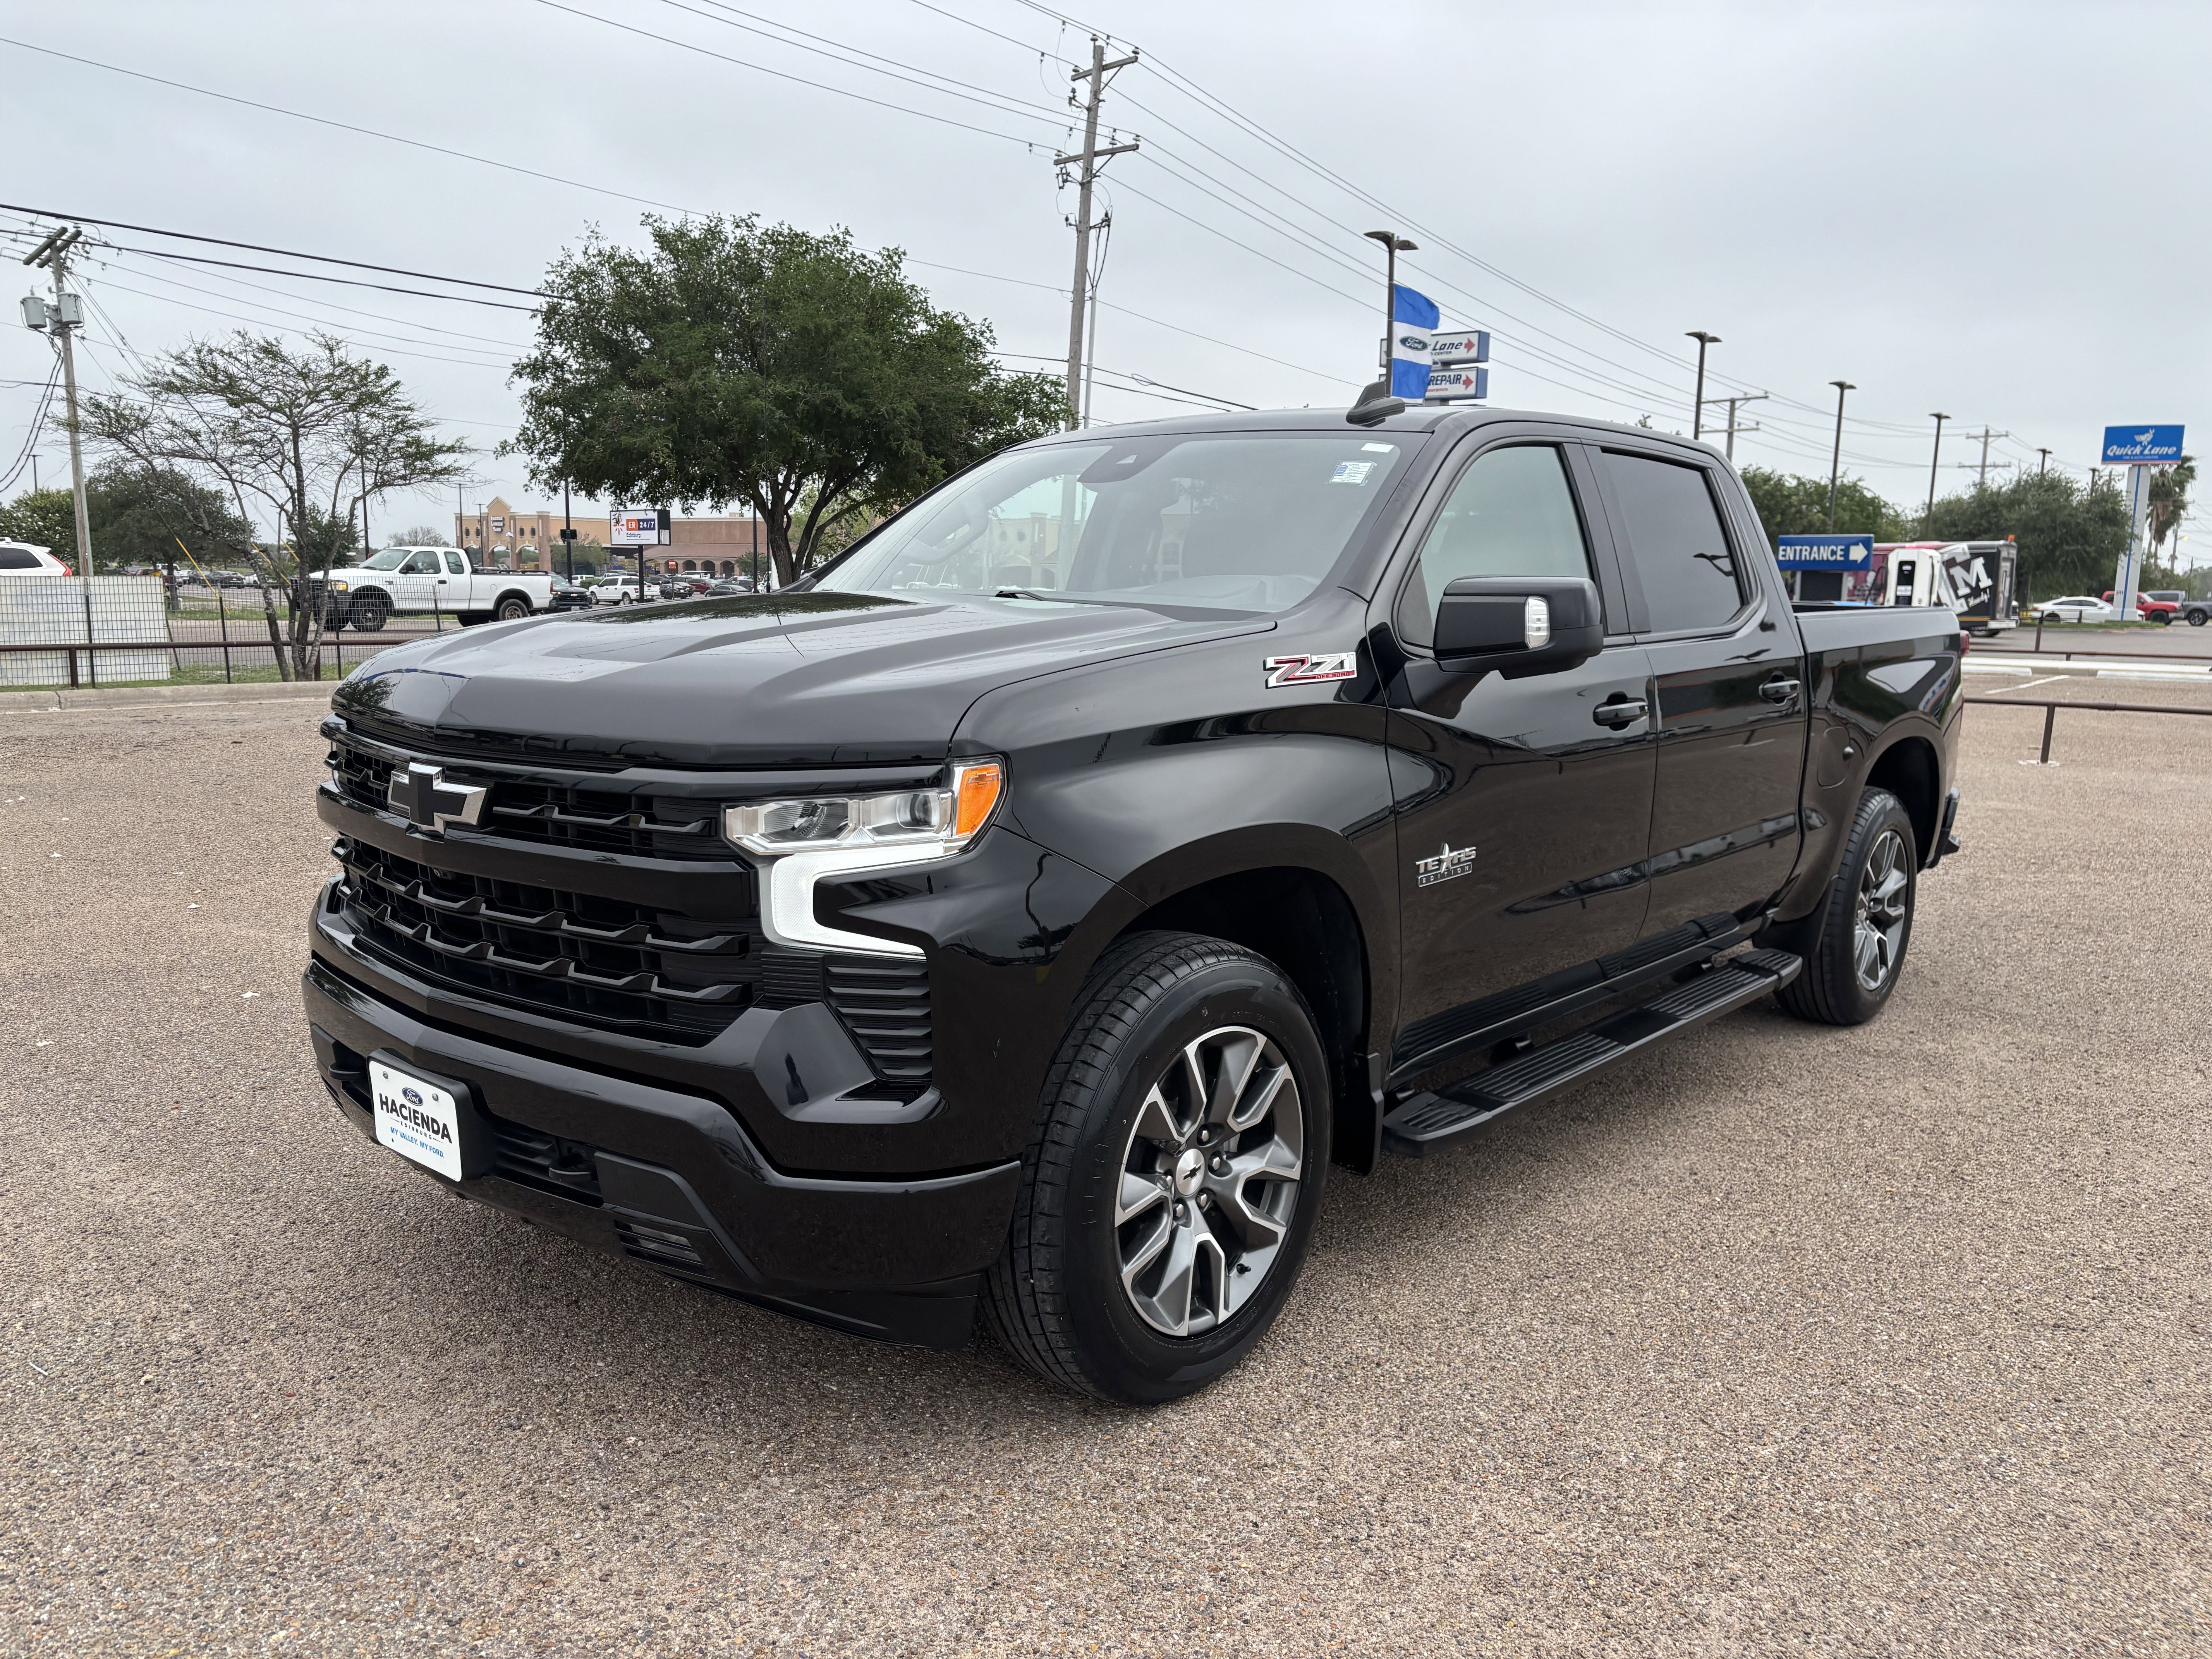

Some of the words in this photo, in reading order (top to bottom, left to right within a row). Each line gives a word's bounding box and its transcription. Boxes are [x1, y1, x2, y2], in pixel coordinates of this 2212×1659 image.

[1432, 340, 1463, 351] Lane
[1429, 374, 1462, 385] REPAIR
[2107, 445, 2143, 457] Quick
[2143, 444, 2176, 455] Lane
[1778, 545, 1845, 561] ENTRANCE
[1266, 652, 1357, 688] Z71
[1422, 866, 1469, 883] EDITION
[379, 1093, 452, 1144] HACIENDA
[400, 1121, 432, 1139] EDINBURG
[390, 1127, 398, 1135] MY
[400, 1131, 418, 1146] VALLEY.
[420, 1141, 428, 1150] MY
[429, 1146, 445, 1158] FORD.
